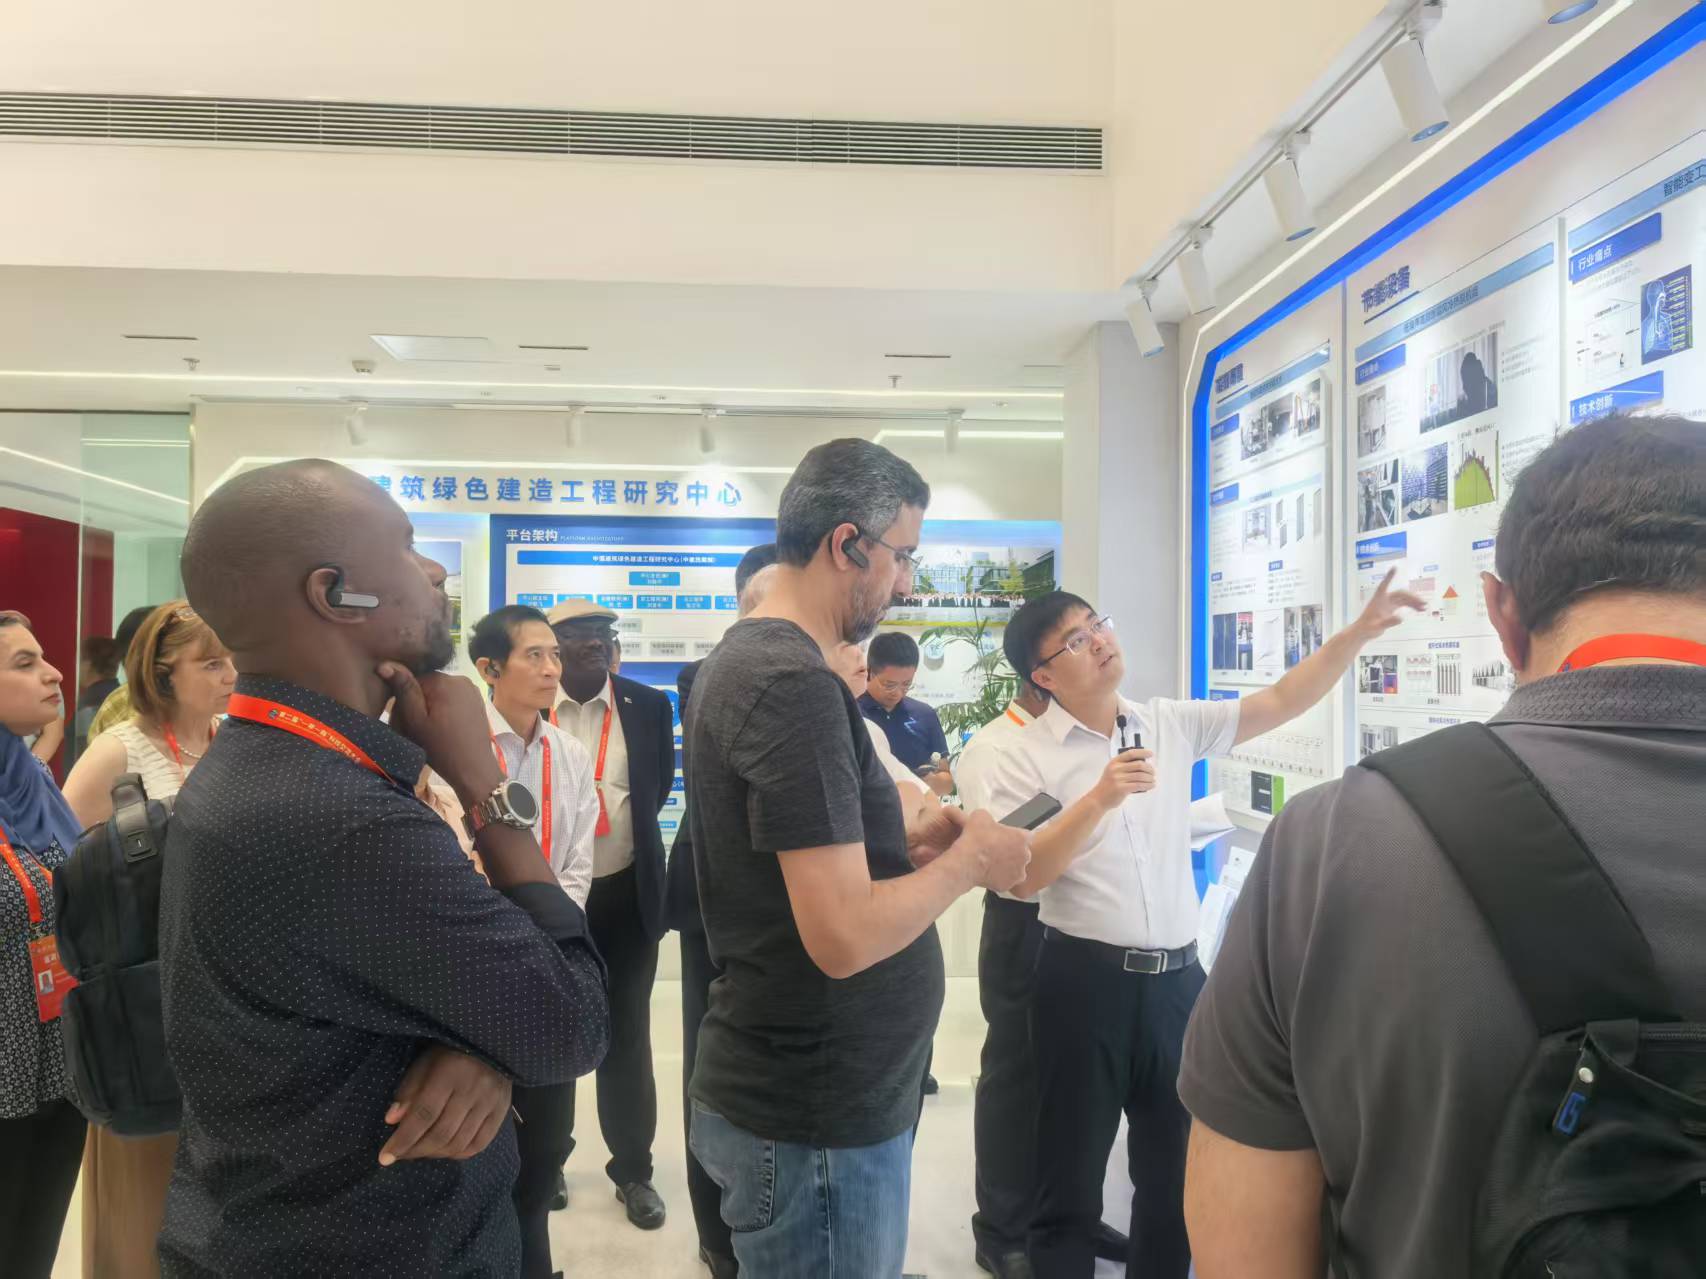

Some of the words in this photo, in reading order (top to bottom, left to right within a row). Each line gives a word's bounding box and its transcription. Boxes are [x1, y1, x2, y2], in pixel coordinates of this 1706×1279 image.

[1579, 393, 1614, 416] 技术创新
[506, 528, 558, 542] 平台架构
